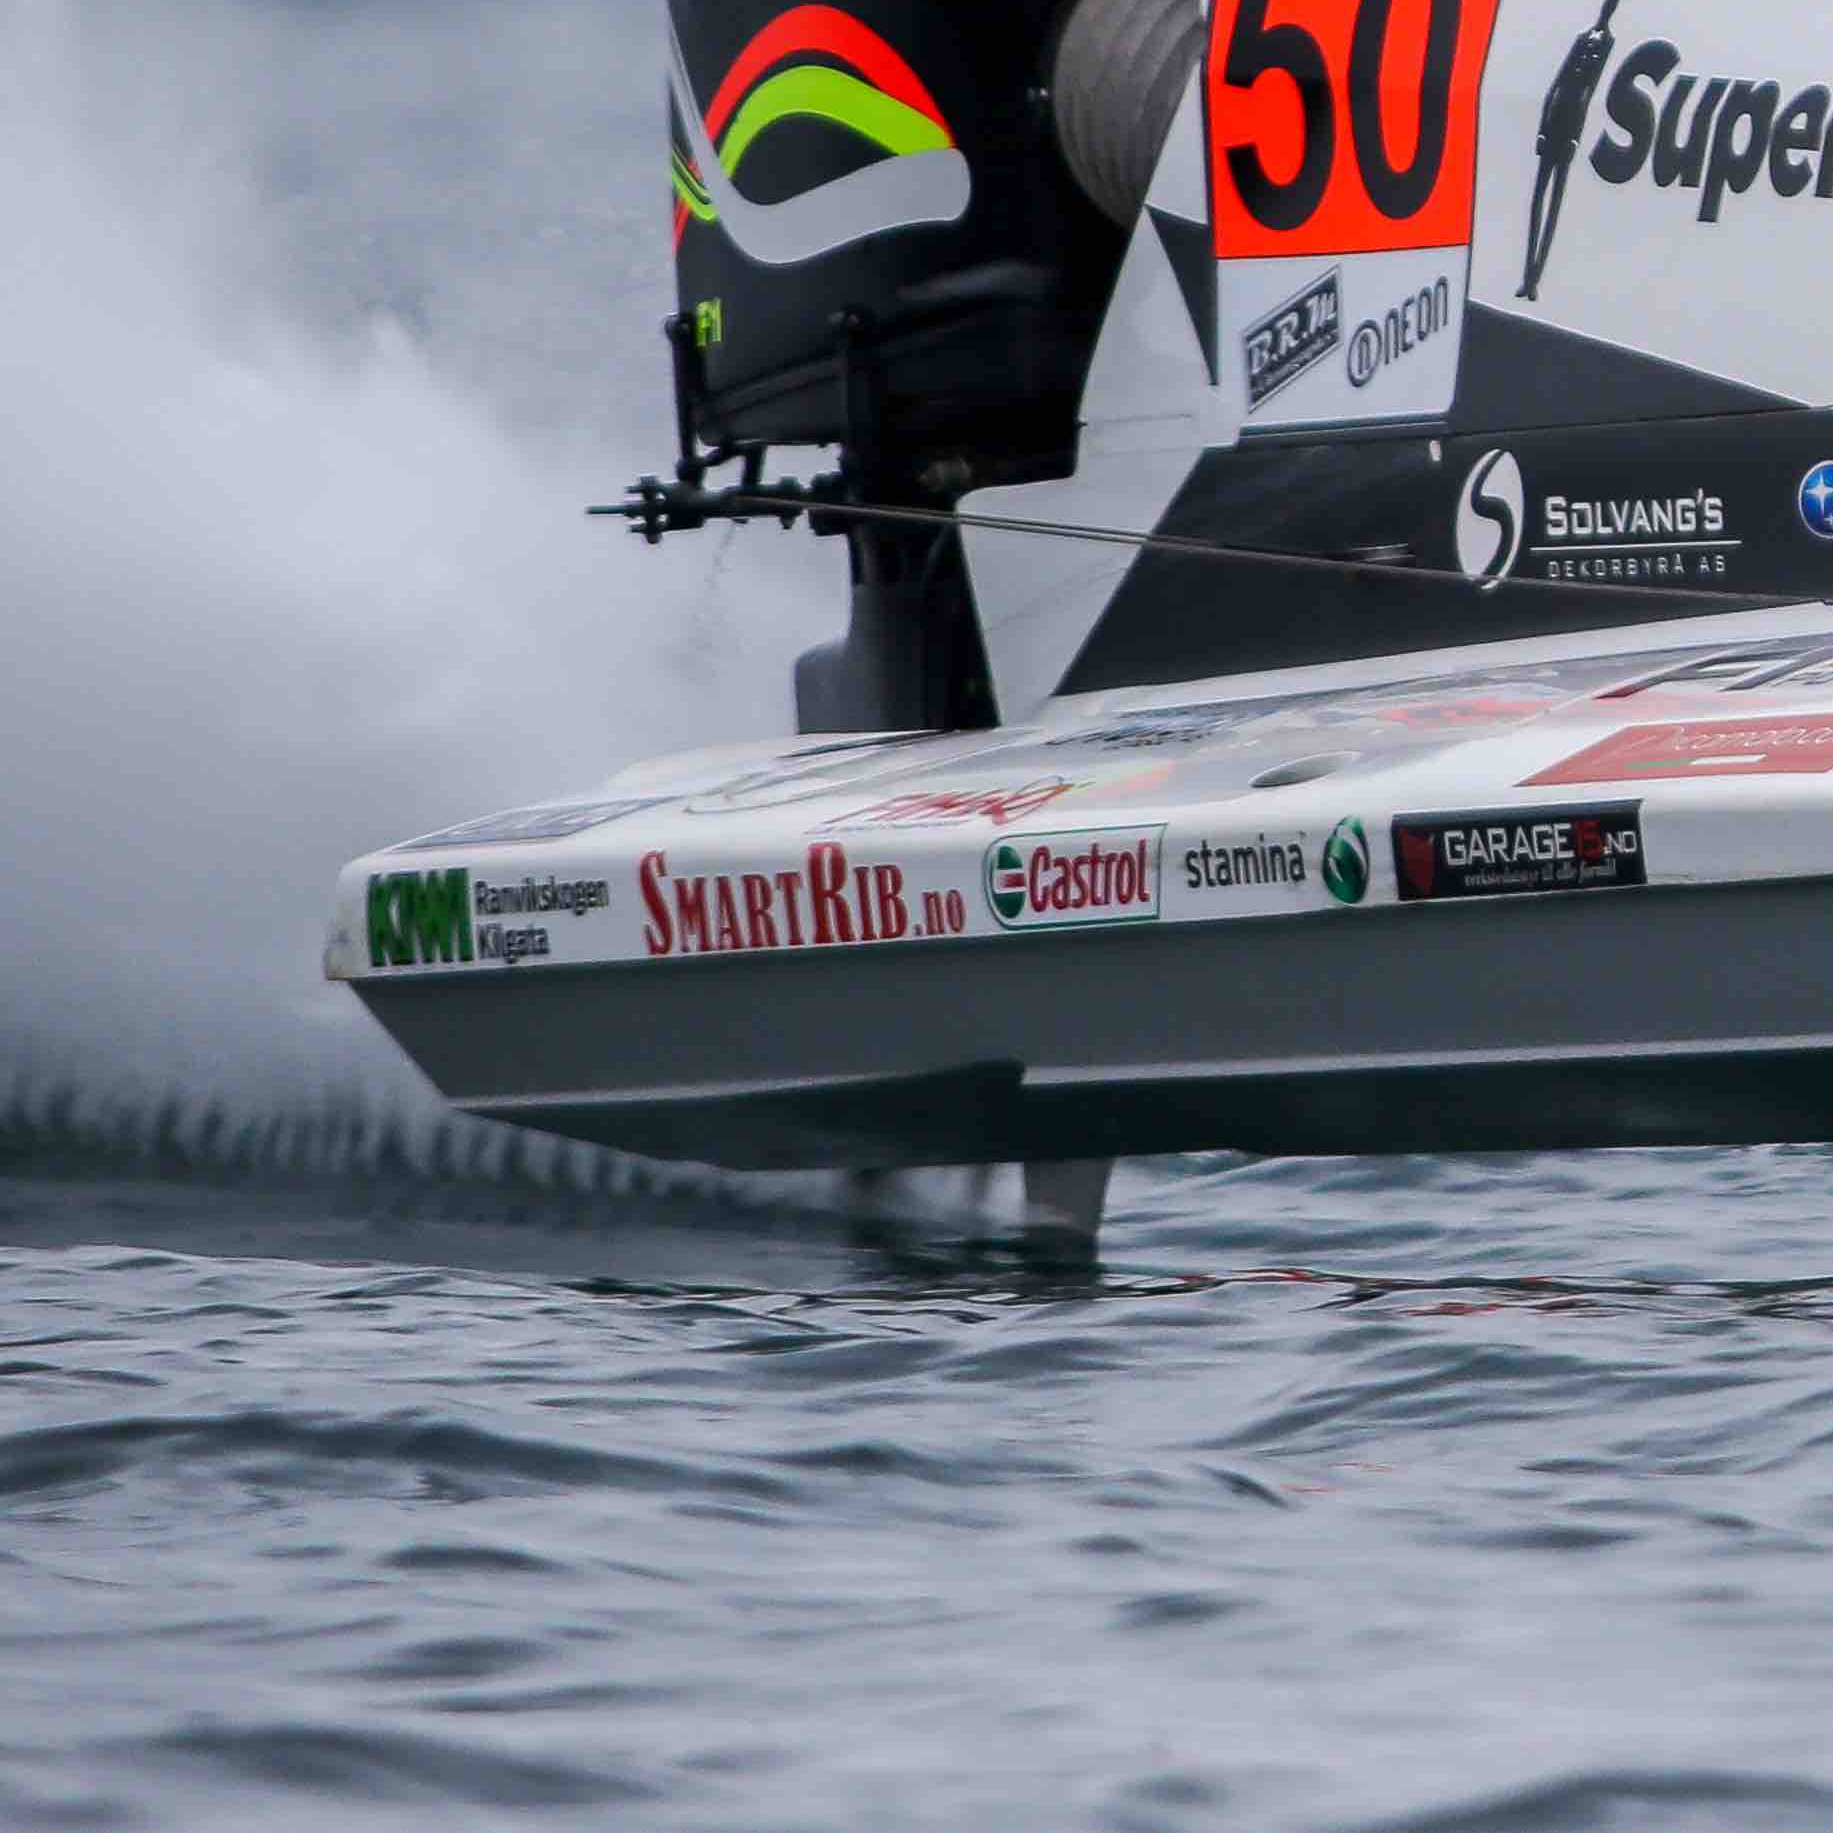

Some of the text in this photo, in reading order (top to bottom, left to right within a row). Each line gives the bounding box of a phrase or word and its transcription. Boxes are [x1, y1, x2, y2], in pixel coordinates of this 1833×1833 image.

[1548, 553, 1726, 578] DEKORBYRÅ AS
[1029, 839, 1151, 913] Castrol
[1185, 835, 1307, 889] stamina
